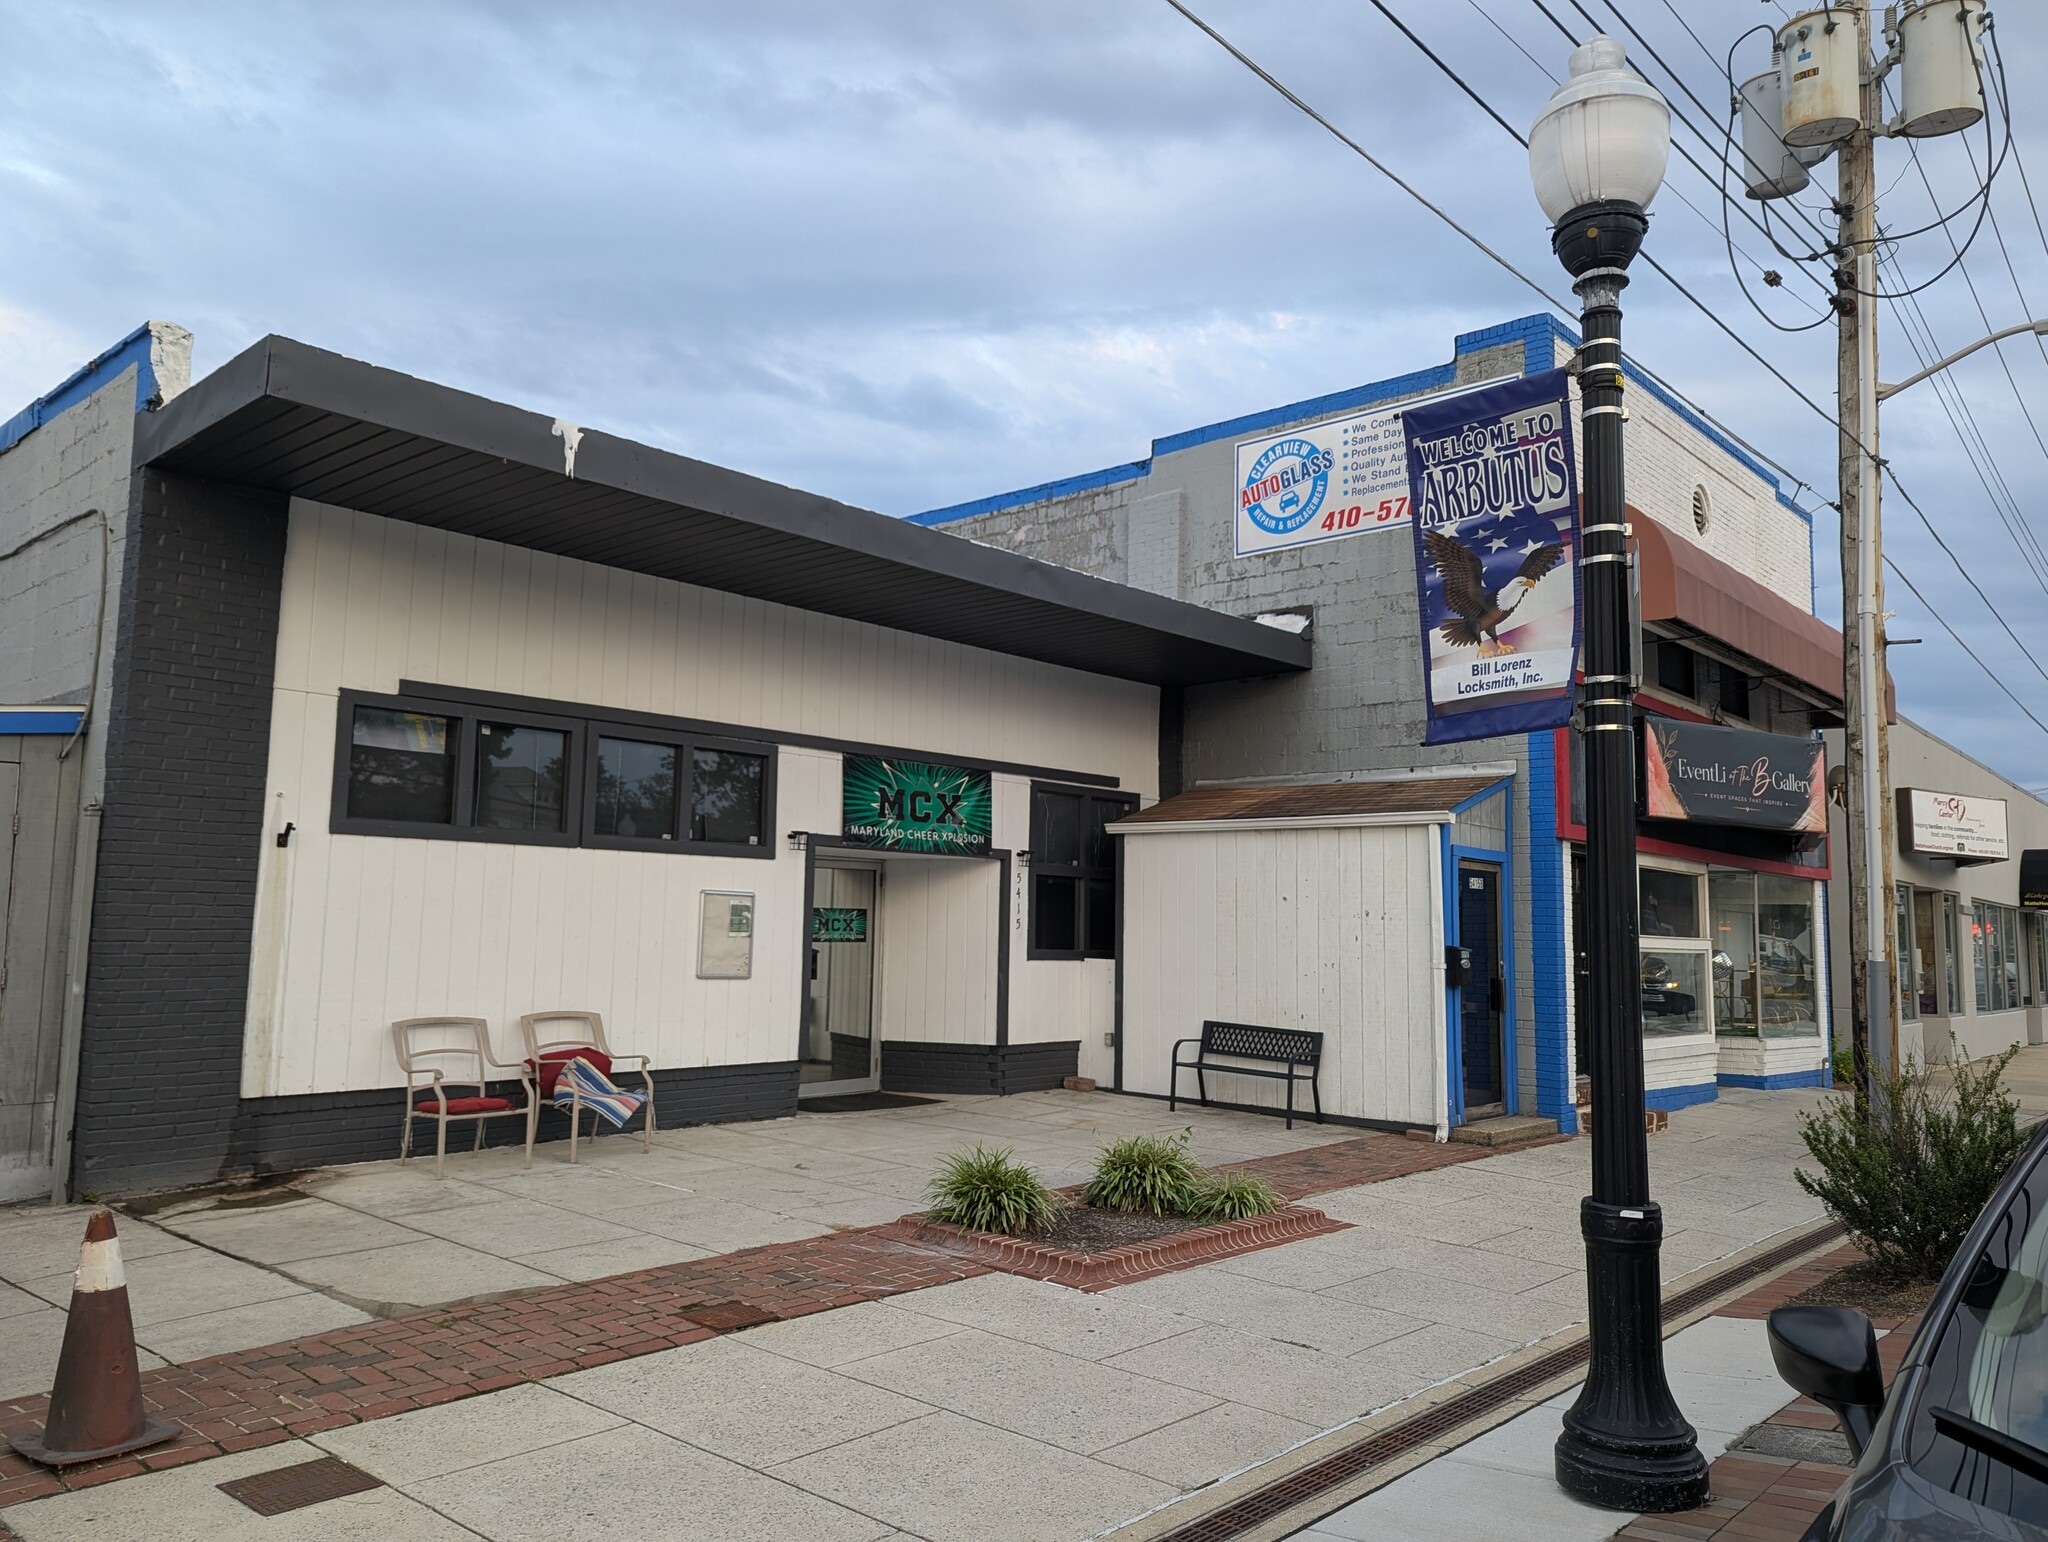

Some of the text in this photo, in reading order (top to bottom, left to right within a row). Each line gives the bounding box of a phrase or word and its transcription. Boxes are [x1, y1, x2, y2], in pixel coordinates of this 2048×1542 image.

[1352, 418, 1400, 434] We Come
[1351, 427, 1402, 446] Same Day
[1421, 412, 1555, 465] WELCOME TO
[1251, 441, 1311, 479] CLEARVIEW
[1351, 457, 1386, 472] Quality
[1241, 449, 1335, 510] AUTOGLASS
[1352, 475, 1366, 484] We
[1371, 465, 1400, 480] Stand
[1420, 437, 1569, 529] ARBUTUS
[1253, 480, 1325, 530] REPAIR & REPLACEMENT
[1471, 658, 1532, 677] Bill Lorenz
[1458, 672, 1543, 694] Locksmith, Inc.
[1678, 758, 1726, 783] EventLi
[1729, 770, 1739, 785] at
[1751, 756, 1772, 797] B
[1772, 771, 1812, 798] Gallery
[878, 786, 964, 826] MCX
[1728, 794, 1748, 802] SPACES
[1763, 799, 1783, 807] INSPIRE
[1939, 809, 1953, 818] Center
[851, 825, 985, 844] MARYLAND CHEER XPLOSION
[818, 918, 854, 931] MCX
